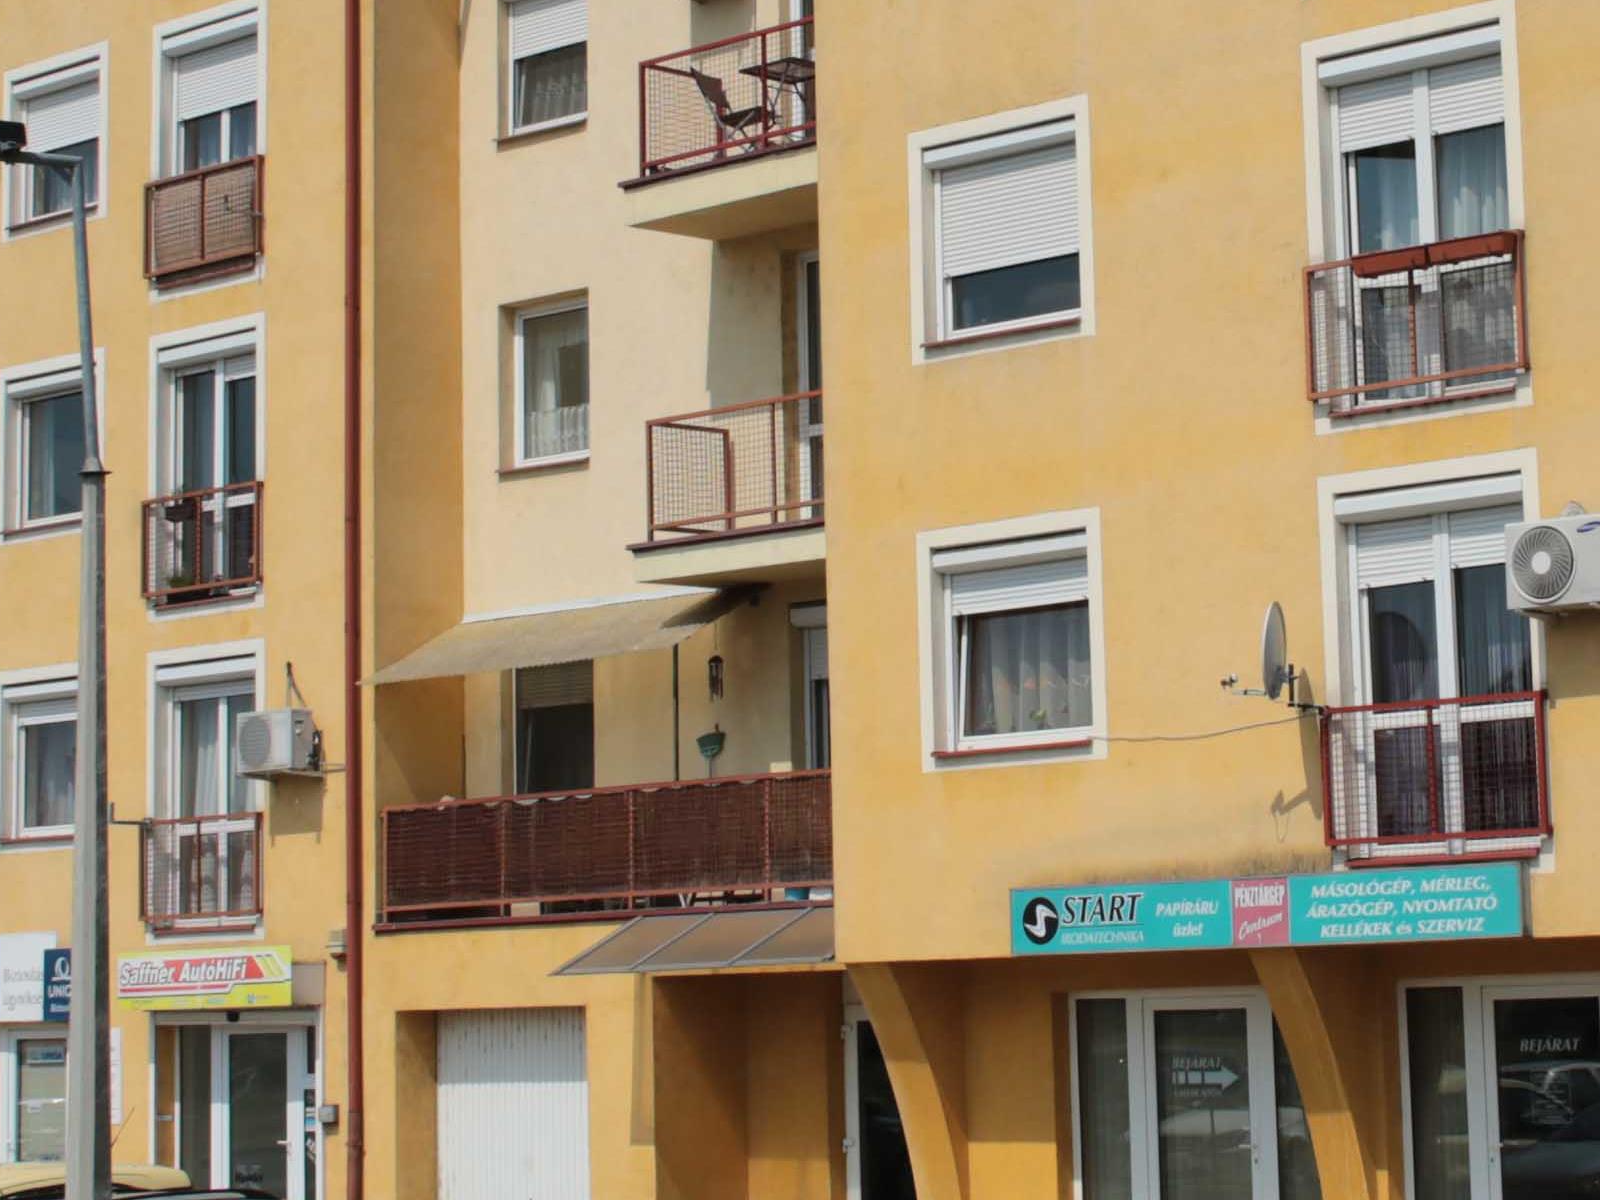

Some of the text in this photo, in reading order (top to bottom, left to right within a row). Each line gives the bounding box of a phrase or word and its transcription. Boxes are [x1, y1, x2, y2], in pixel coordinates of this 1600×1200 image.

[1311, 875, 1491, 898] MÁSOLÓGÉP, MÉRLEG,
[1063, 892, 1143, 924] START
[1156, 899, 1219, 917] PAPÍRÁRU
[1307, 896, 1497, 919] ÁRAZÓGÉP, NYOMTATÓ
[1173, 922, 1203, 937] üzlet
[1320, 917, 1484, 938] KELLÉKEK és SZERVIZ
